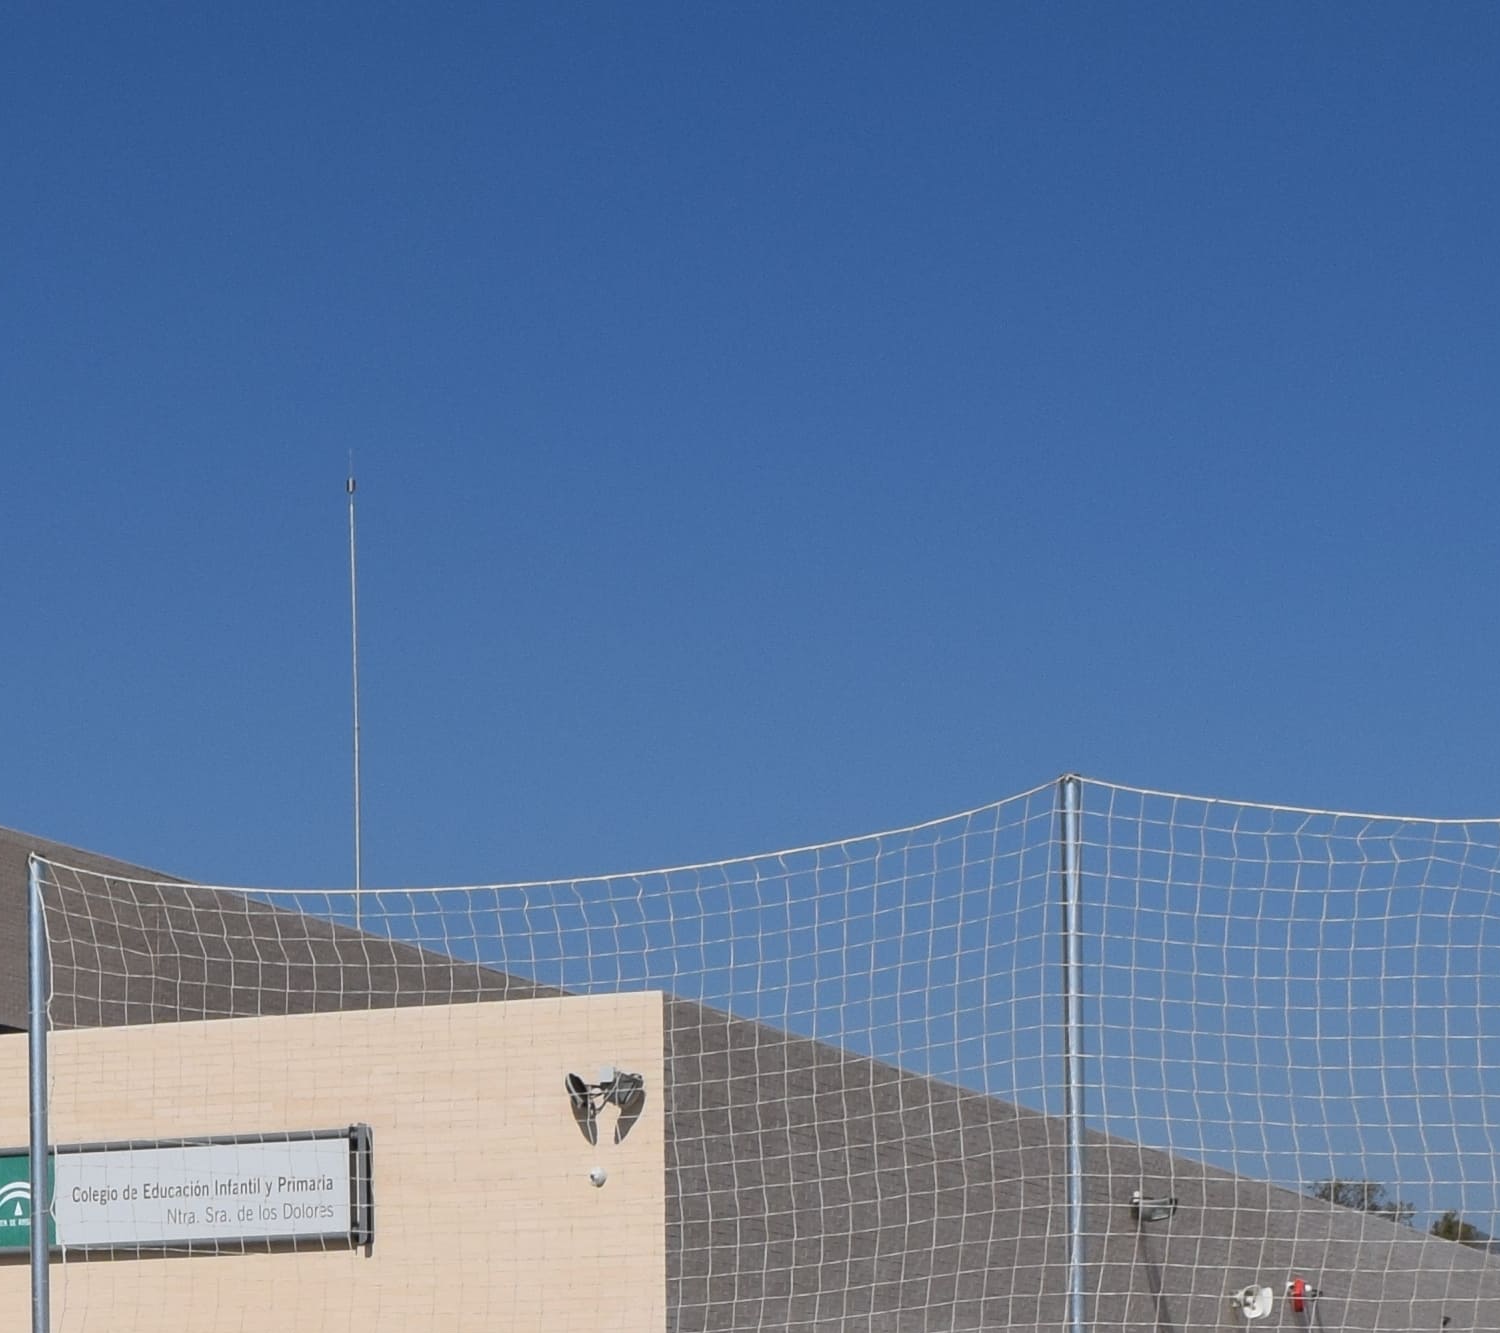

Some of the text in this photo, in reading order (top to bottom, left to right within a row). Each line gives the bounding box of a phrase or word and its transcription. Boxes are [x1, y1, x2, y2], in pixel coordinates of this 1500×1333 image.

[72, 1175, 334, 1205] Colegio de Educación Infantil y Primaria
[167, 1203, 335, 1224] Ntra. Sra. de los Dolores
